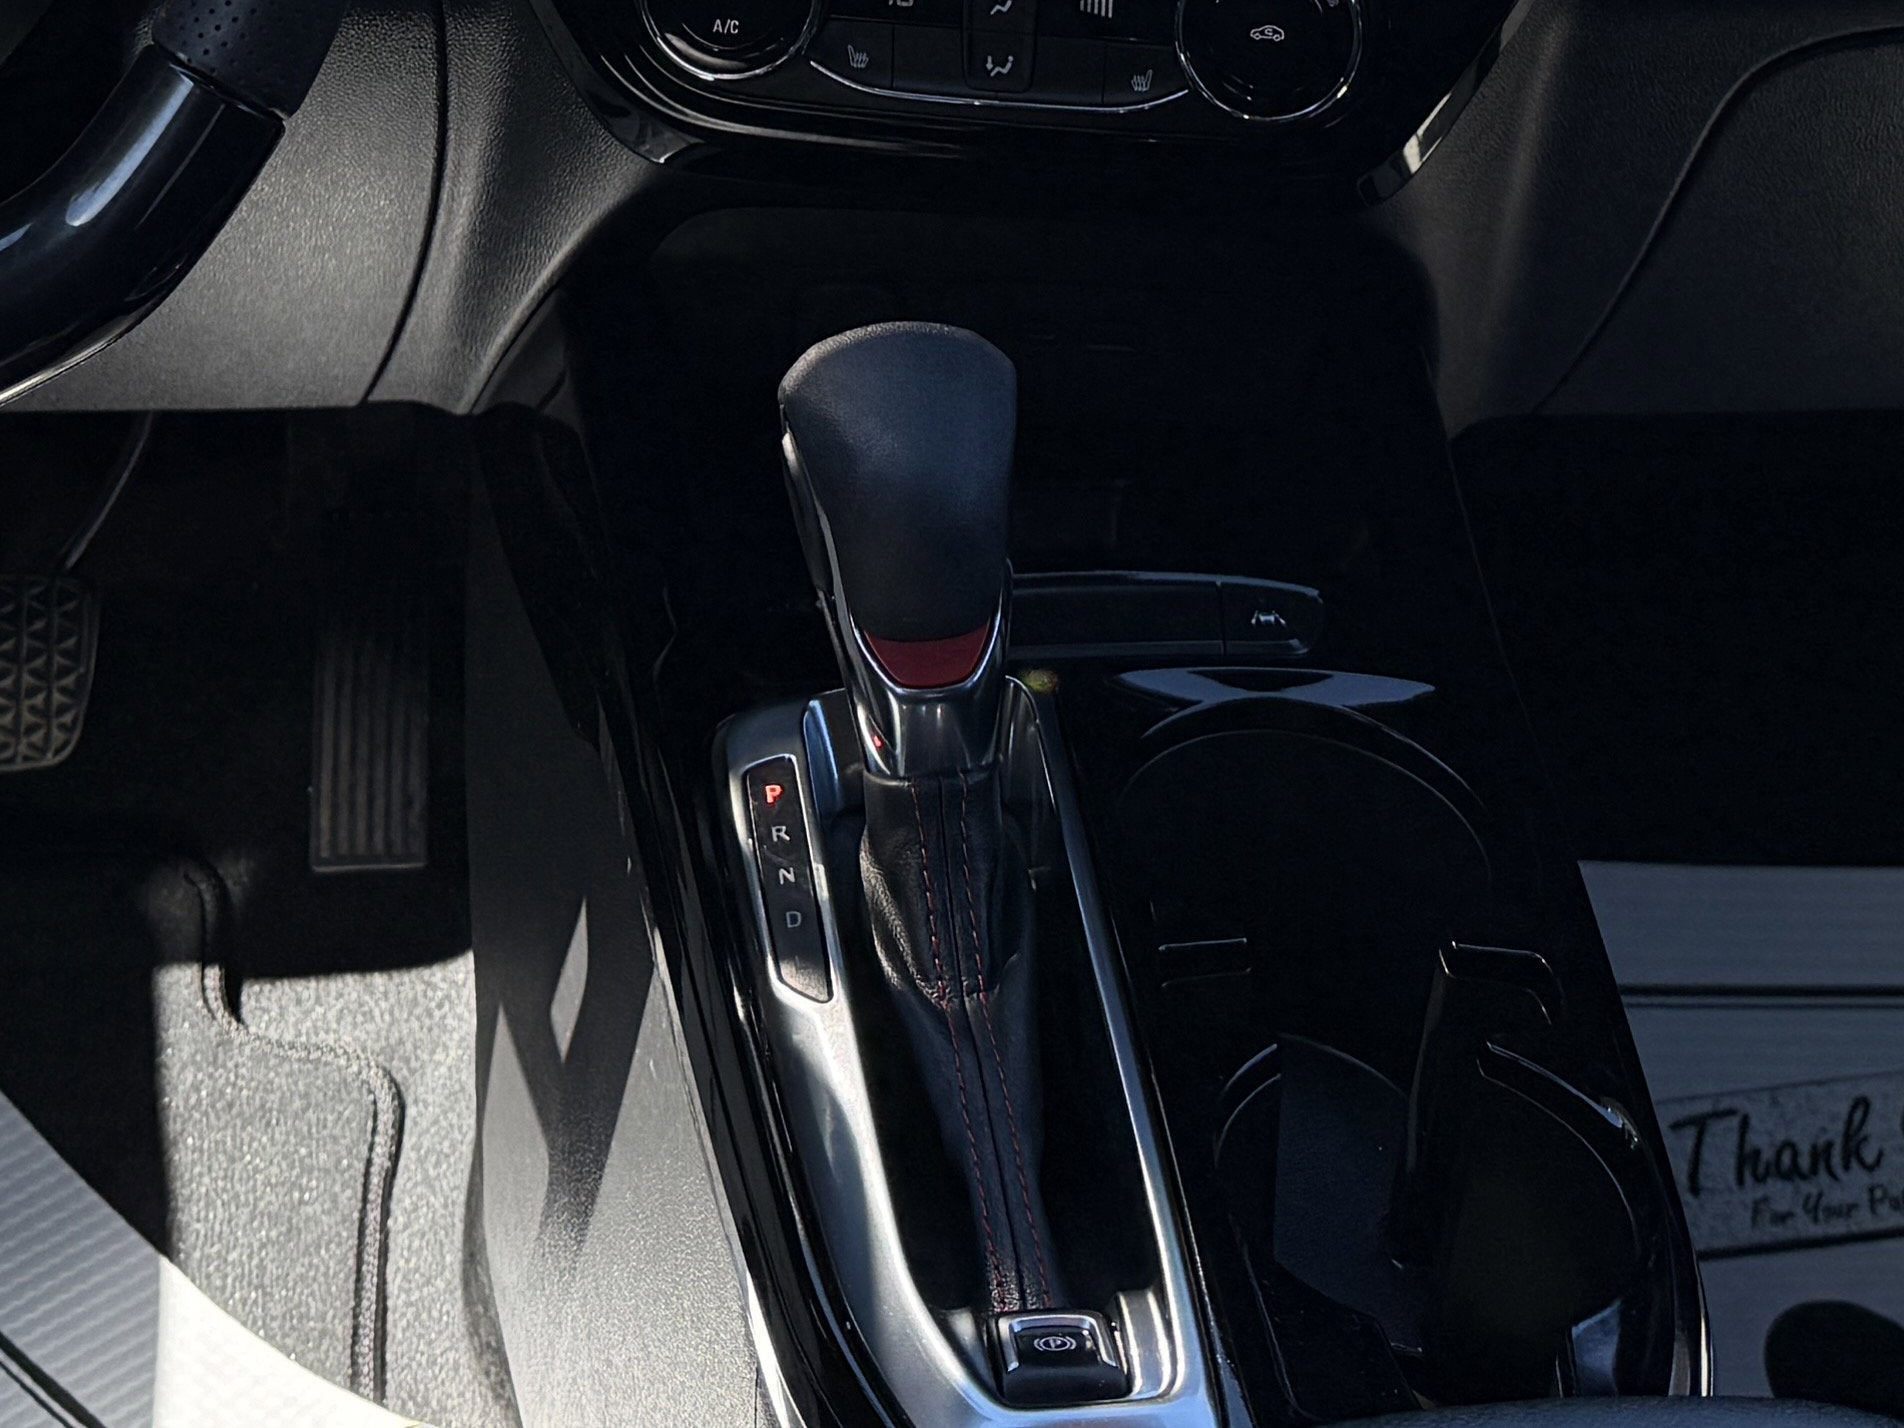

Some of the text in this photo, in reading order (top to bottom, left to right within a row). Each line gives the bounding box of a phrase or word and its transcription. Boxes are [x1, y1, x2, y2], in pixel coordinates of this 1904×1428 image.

[712, 18, 740, 35] A/C
[765, 784, 782, 804] P
[771, 825, 791, 842] R
[778, 867, 796, 885] N
[785, 911, 802, 929] D
[1669, 1095, 1884, 1200] Thank
[1750, 1200, 1797, 1230] For
[1801, 1189, 1861, 1222] Your
